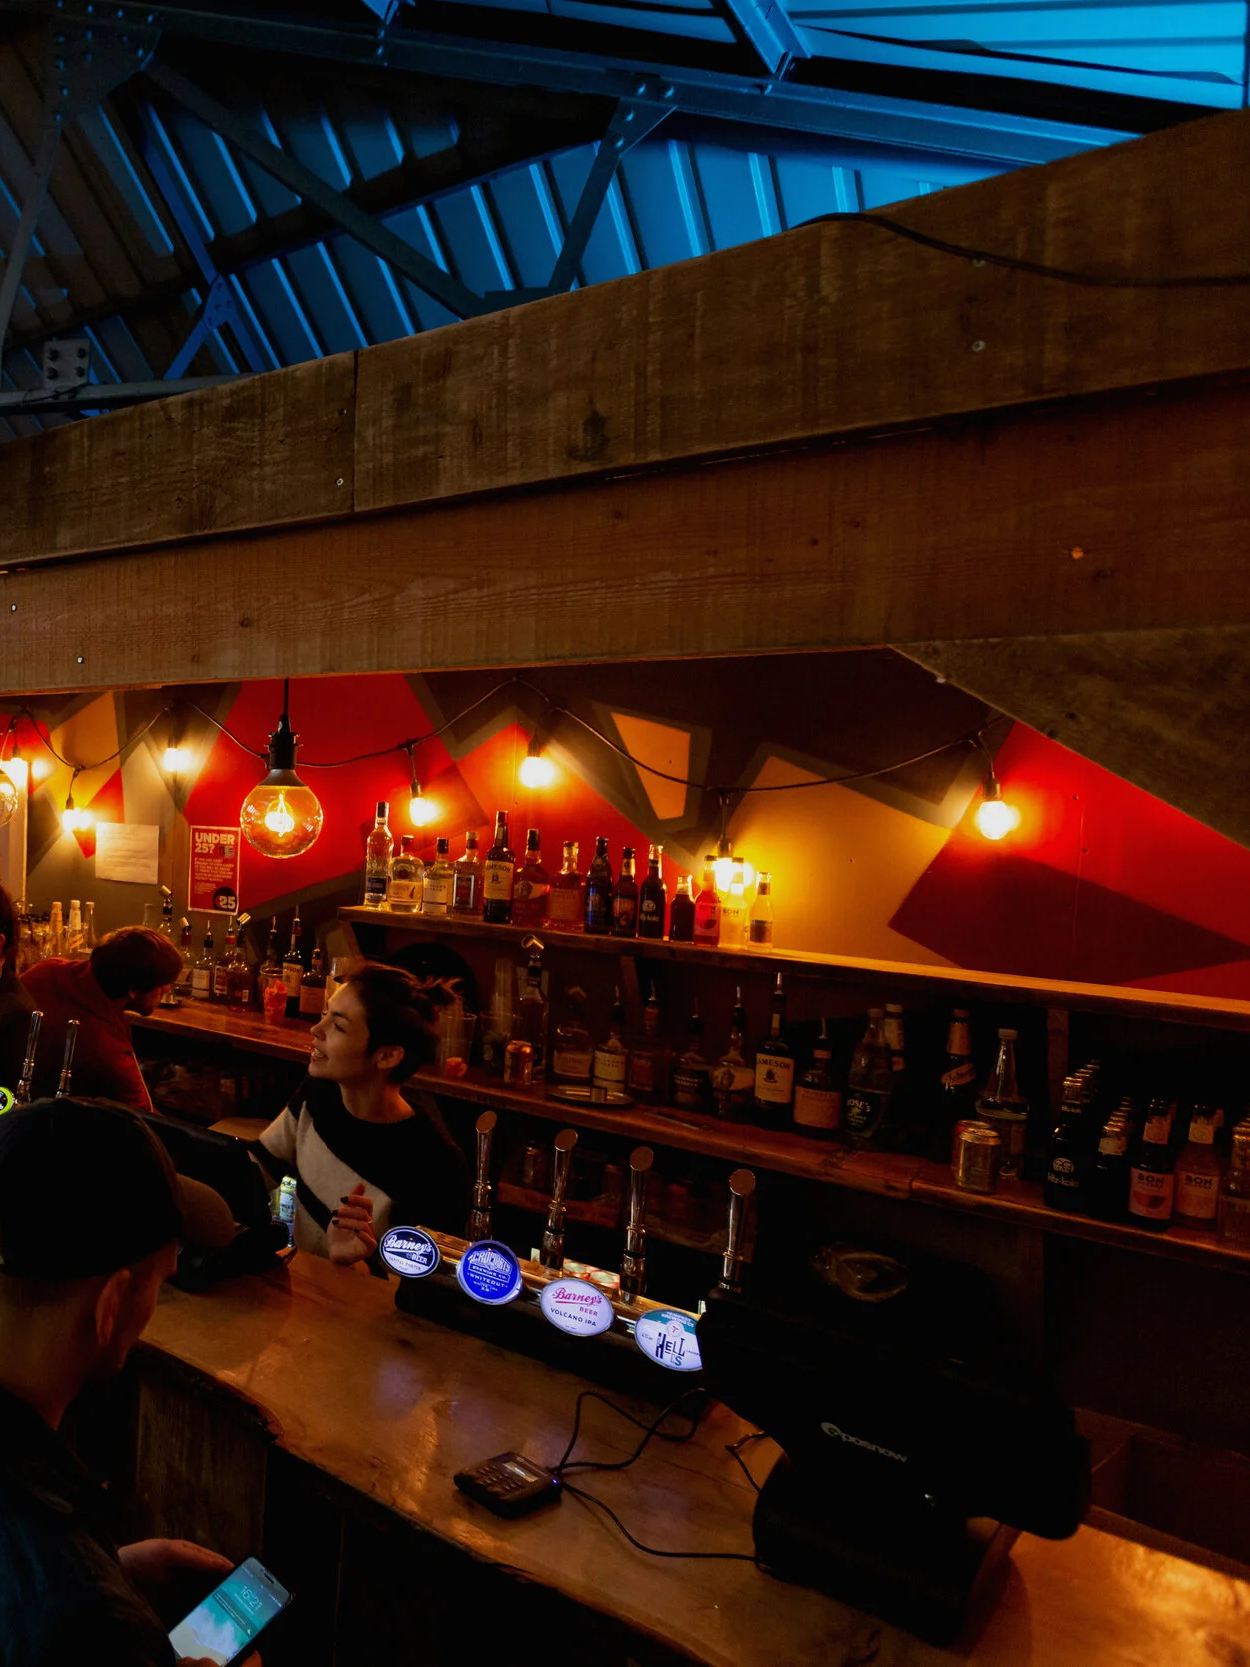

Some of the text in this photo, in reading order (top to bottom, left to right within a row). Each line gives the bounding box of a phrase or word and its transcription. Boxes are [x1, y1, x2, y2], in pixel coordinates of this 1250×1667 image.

[194, 832, 236, 845] UNDER
[194, 843, 215, 854] 25?
[219, 895, 236, 909] 25
[757, 1057, 791, 1070] AMESON
[383, 1234, 433, 1256] Barney's
[411, 1253, 428, 1265] BEER
[469, 1273, 505, 1288] WHITEOUT
[551, 1287, 603, 1307] Barney's
[550, 1307, 597, 1327] VOLCANO IPA
[579, 1306, 598, 1316] BEER
